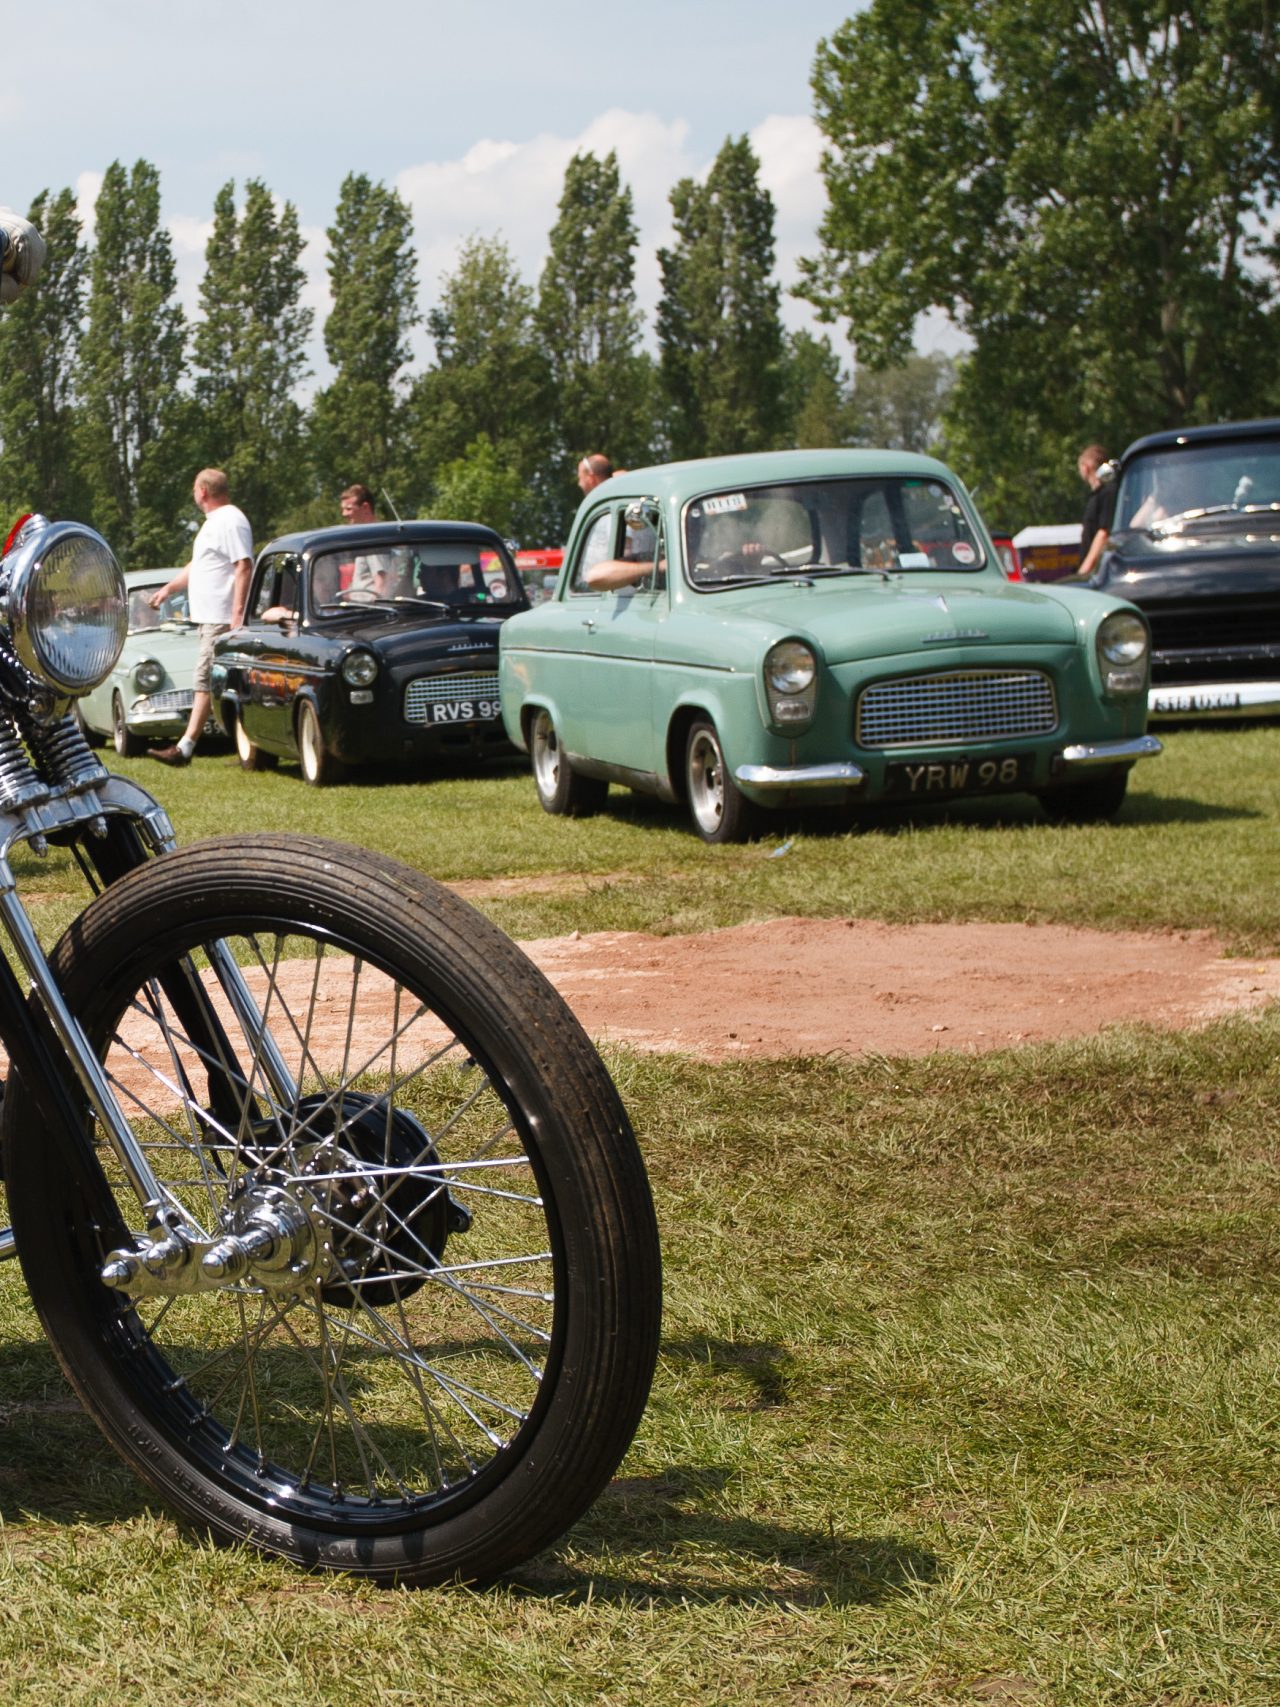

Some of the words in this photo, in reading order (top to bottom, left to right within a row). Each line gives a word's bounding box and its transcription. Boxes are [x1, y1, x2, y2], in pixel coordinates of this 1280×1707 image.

[433, 701, 474, 721] RVS
[905, 764, 969, 791] YRW
[978, 758, 1018, 786] 98
